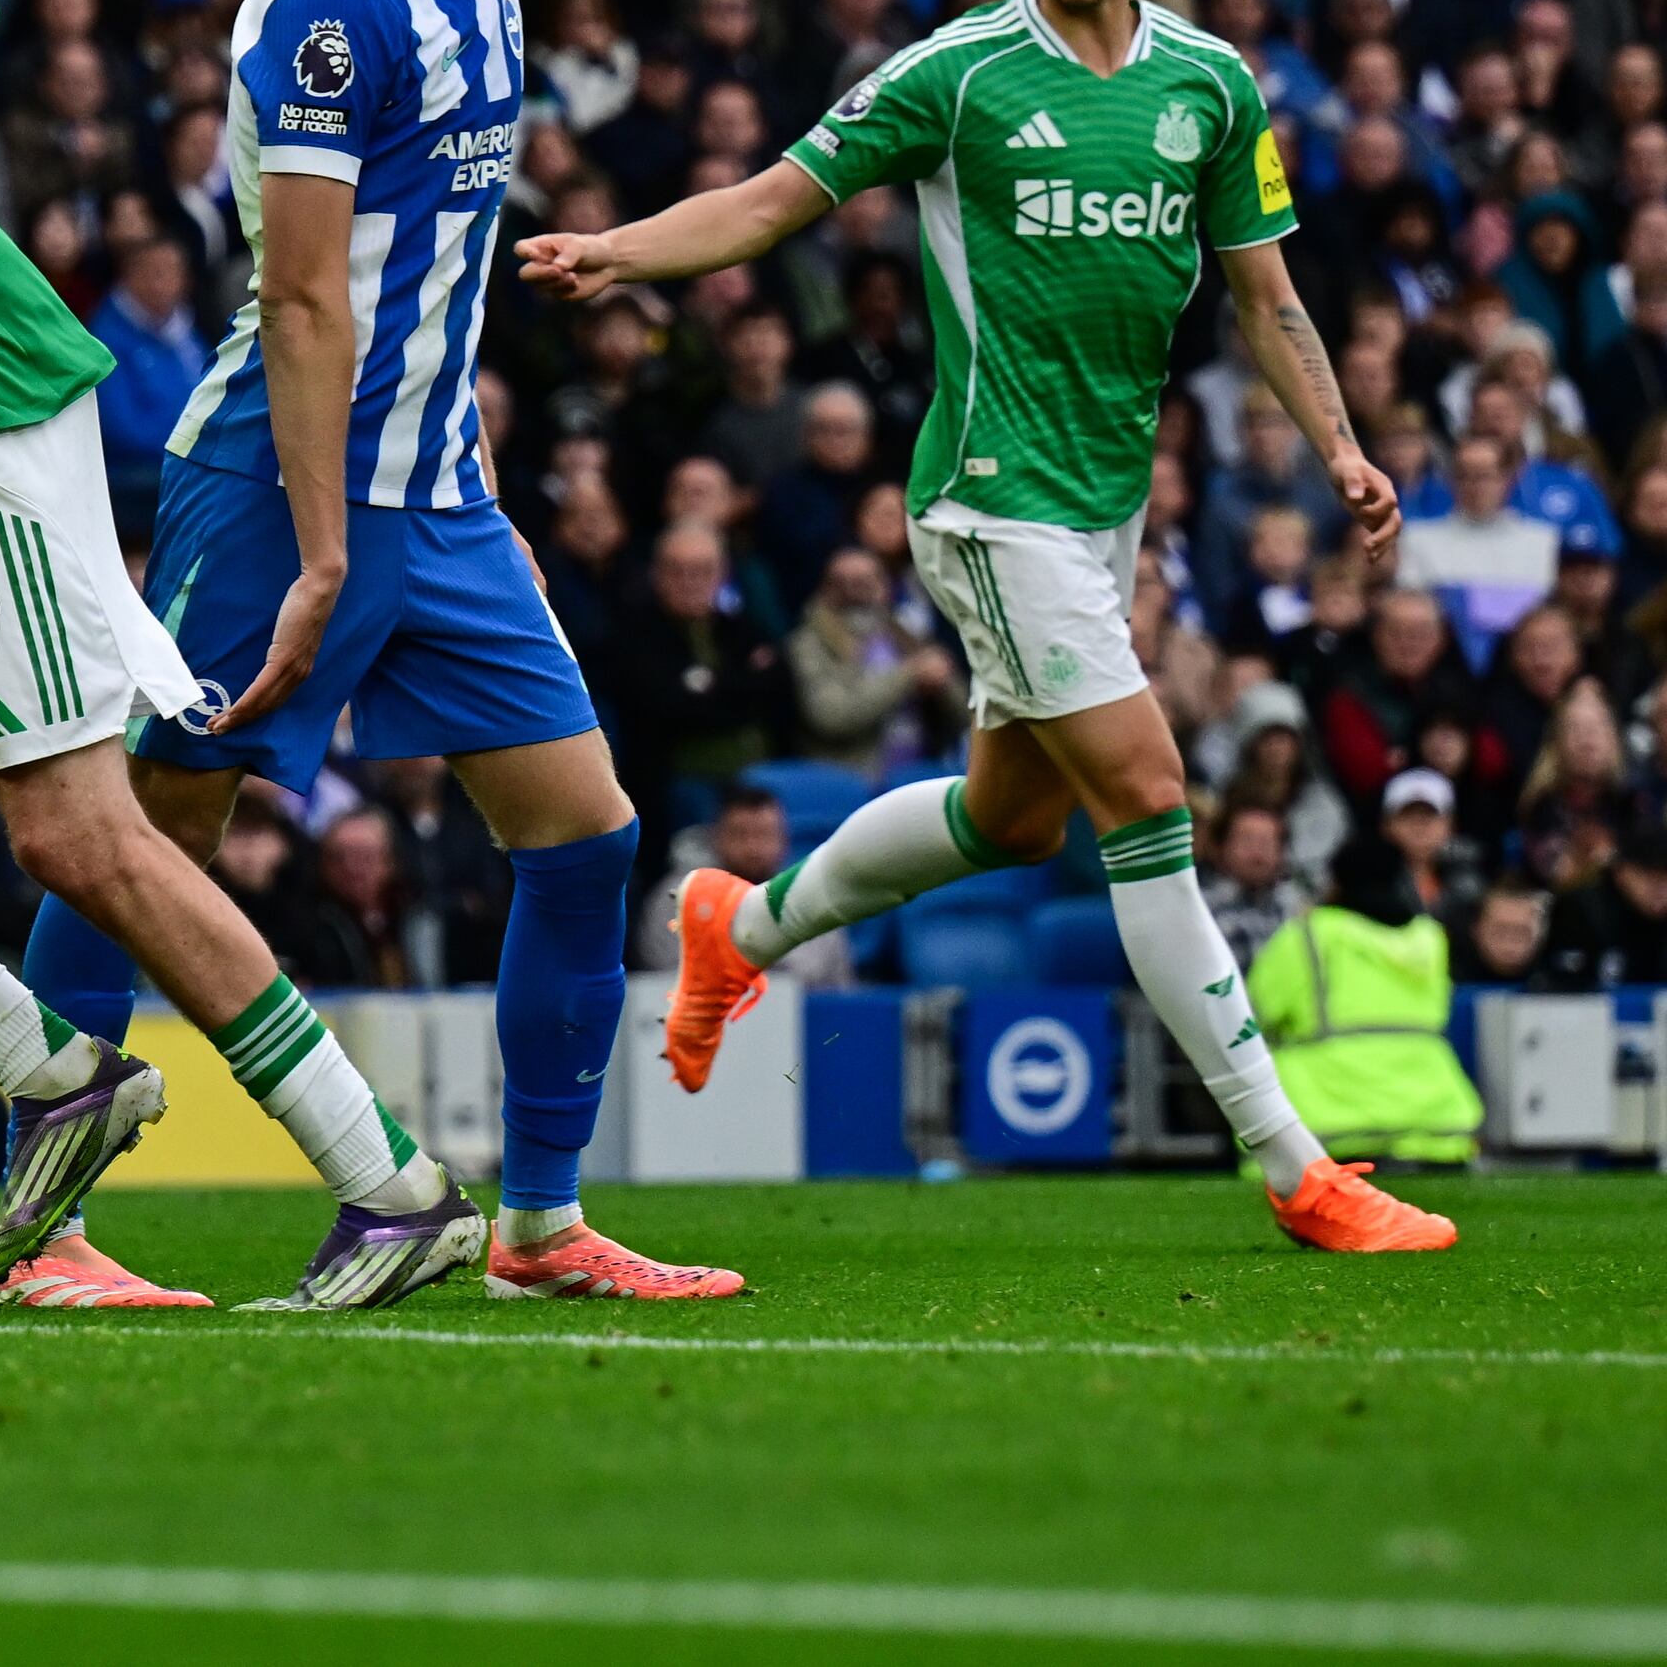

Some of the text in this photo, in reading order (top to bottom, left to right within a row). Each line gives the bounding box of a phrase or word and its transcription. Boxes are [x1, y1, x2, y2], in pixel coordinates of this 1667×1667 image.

[280, 103, 344, 123] No room
[302, 120, 348, 135] racism
[1078, 181, 1195, 237] sela
